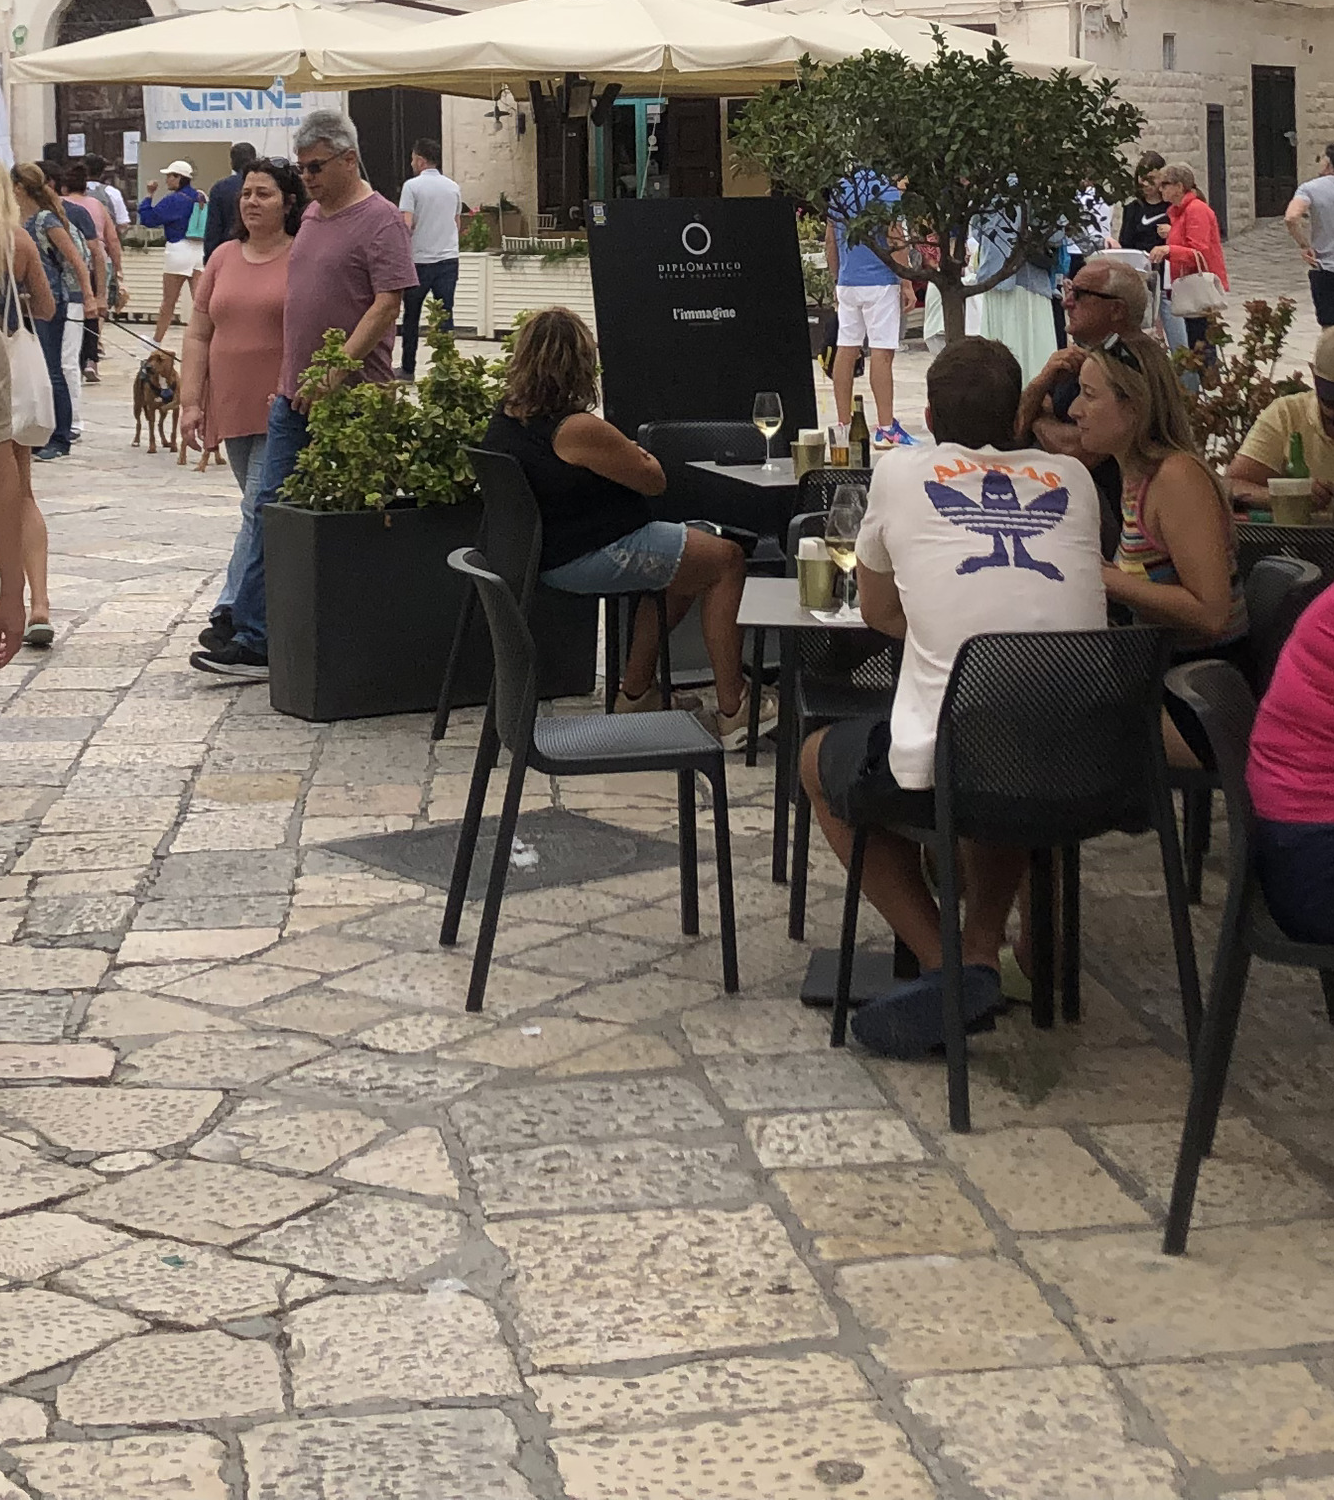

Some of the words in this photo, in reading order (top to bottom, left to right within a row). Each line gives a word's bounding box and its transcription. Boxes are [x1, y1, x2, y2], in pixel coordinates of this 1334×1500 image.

[156, 119, 224, 130] COSTRUZIONI
[226, 118, 232, 129] E
[234, 116, 304, 128] RISTRUTTURA
[658, 262, 741, 272] DIPLOMATICO
